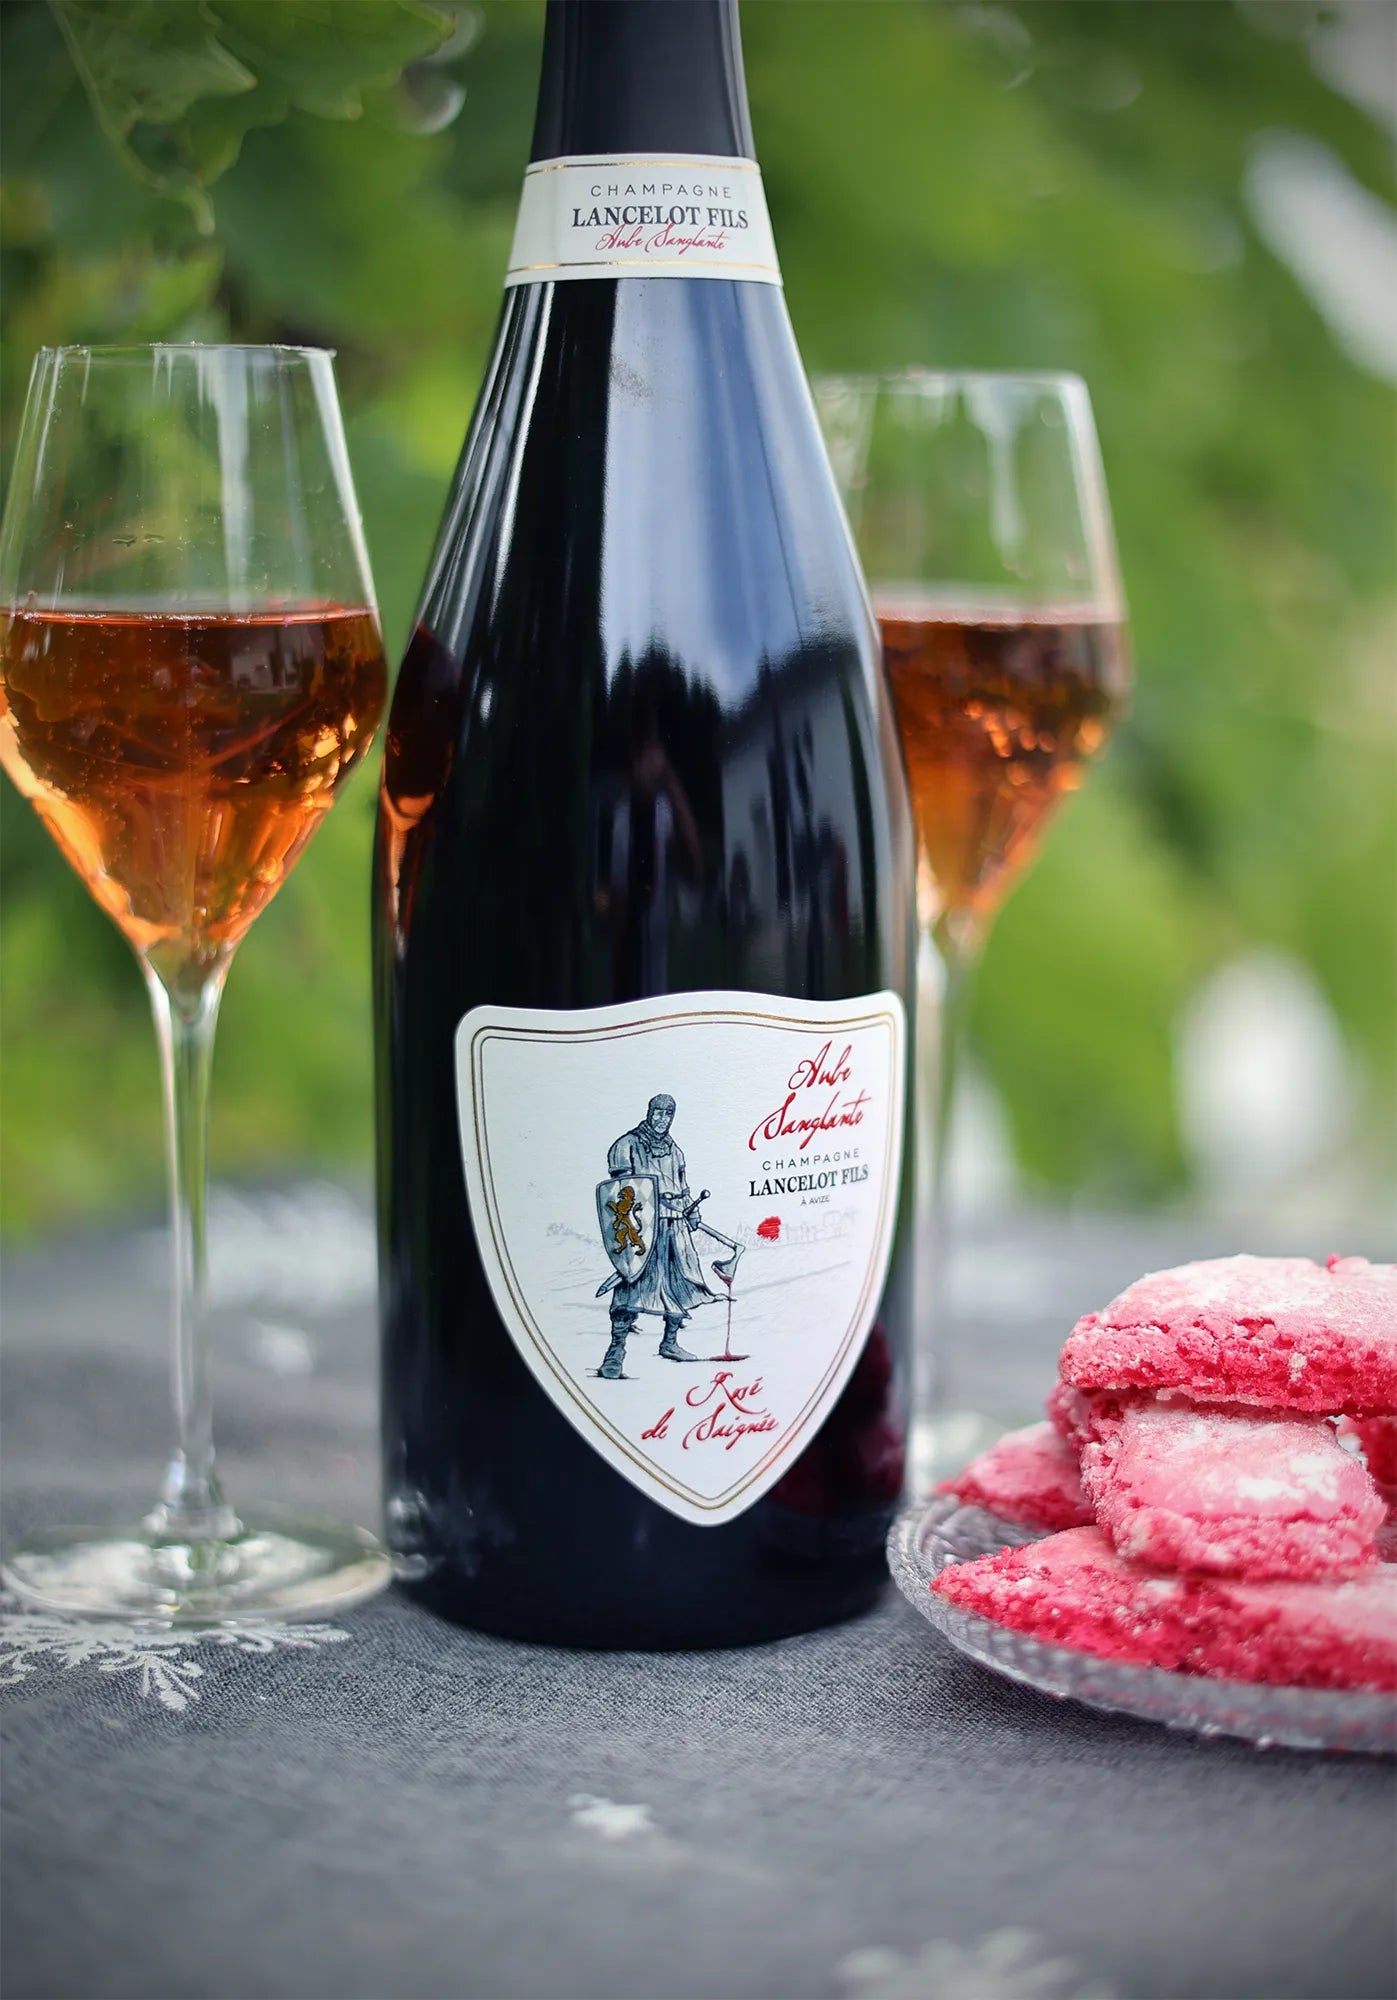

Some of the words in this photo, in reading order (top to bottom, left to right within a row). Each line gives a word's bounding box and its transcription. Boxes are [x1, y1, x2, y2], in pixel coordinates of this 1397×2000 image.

[590, 183, 732, 199] CHAMPAGNE
[572, 205, 700, 228] LANCELOT
[707, 208, 749, 229] FILS
[595, 223, 643, 251] Aube
[644, 221, 731, 255] Sanglante
[788, 1040, 852, 1090] Aube
[748, 1089, 872, 1151] Sanglante
[762, 1148, 860, 1171] CHAMPAGNE
[749, 1170, 838, 1197] LANCELOT
[841, 1164, 869, 1185] FILS
[809, 1195, 831, 1204] AVIZE
[686, 1371, 768, 1415] Rosé
[640, 1407, 675, 1440] de
[682, 1402, 779, 1450] Saignée
